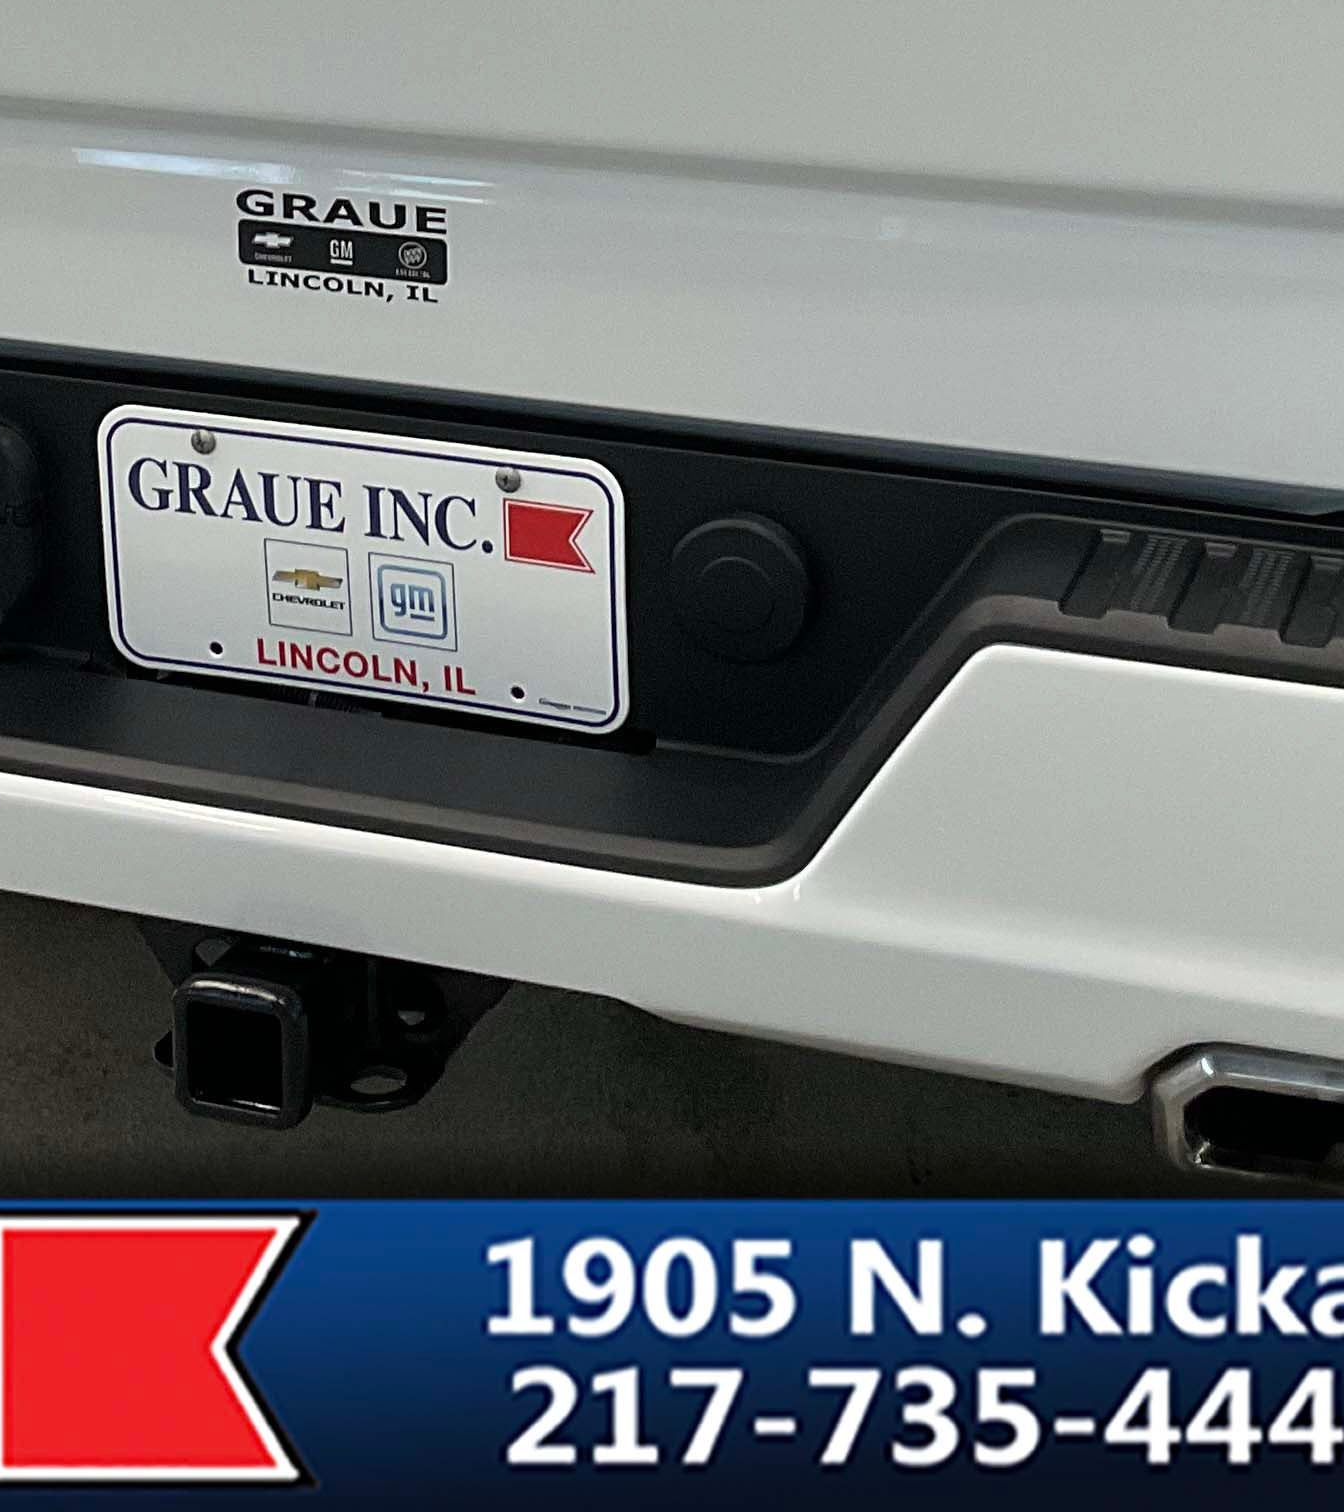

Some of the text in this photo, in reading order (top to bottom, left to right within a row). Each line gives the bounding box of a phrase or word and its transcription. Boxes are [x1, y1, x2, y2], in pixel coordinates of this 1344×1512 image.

[235, 188, 448, 235] GRAUE
[329, 239, 354, 260] GM
[247, 268, 394, 303] LINCOLN,
[406, 285, 439, 304] IL
[127, 456, 495, 555] GRAUE INC.
[271, 591, 346, 611] CHEVROLET
[389, 582, 436, 618] gm
[256, 637, 477, 696] LINCOLN, IL
